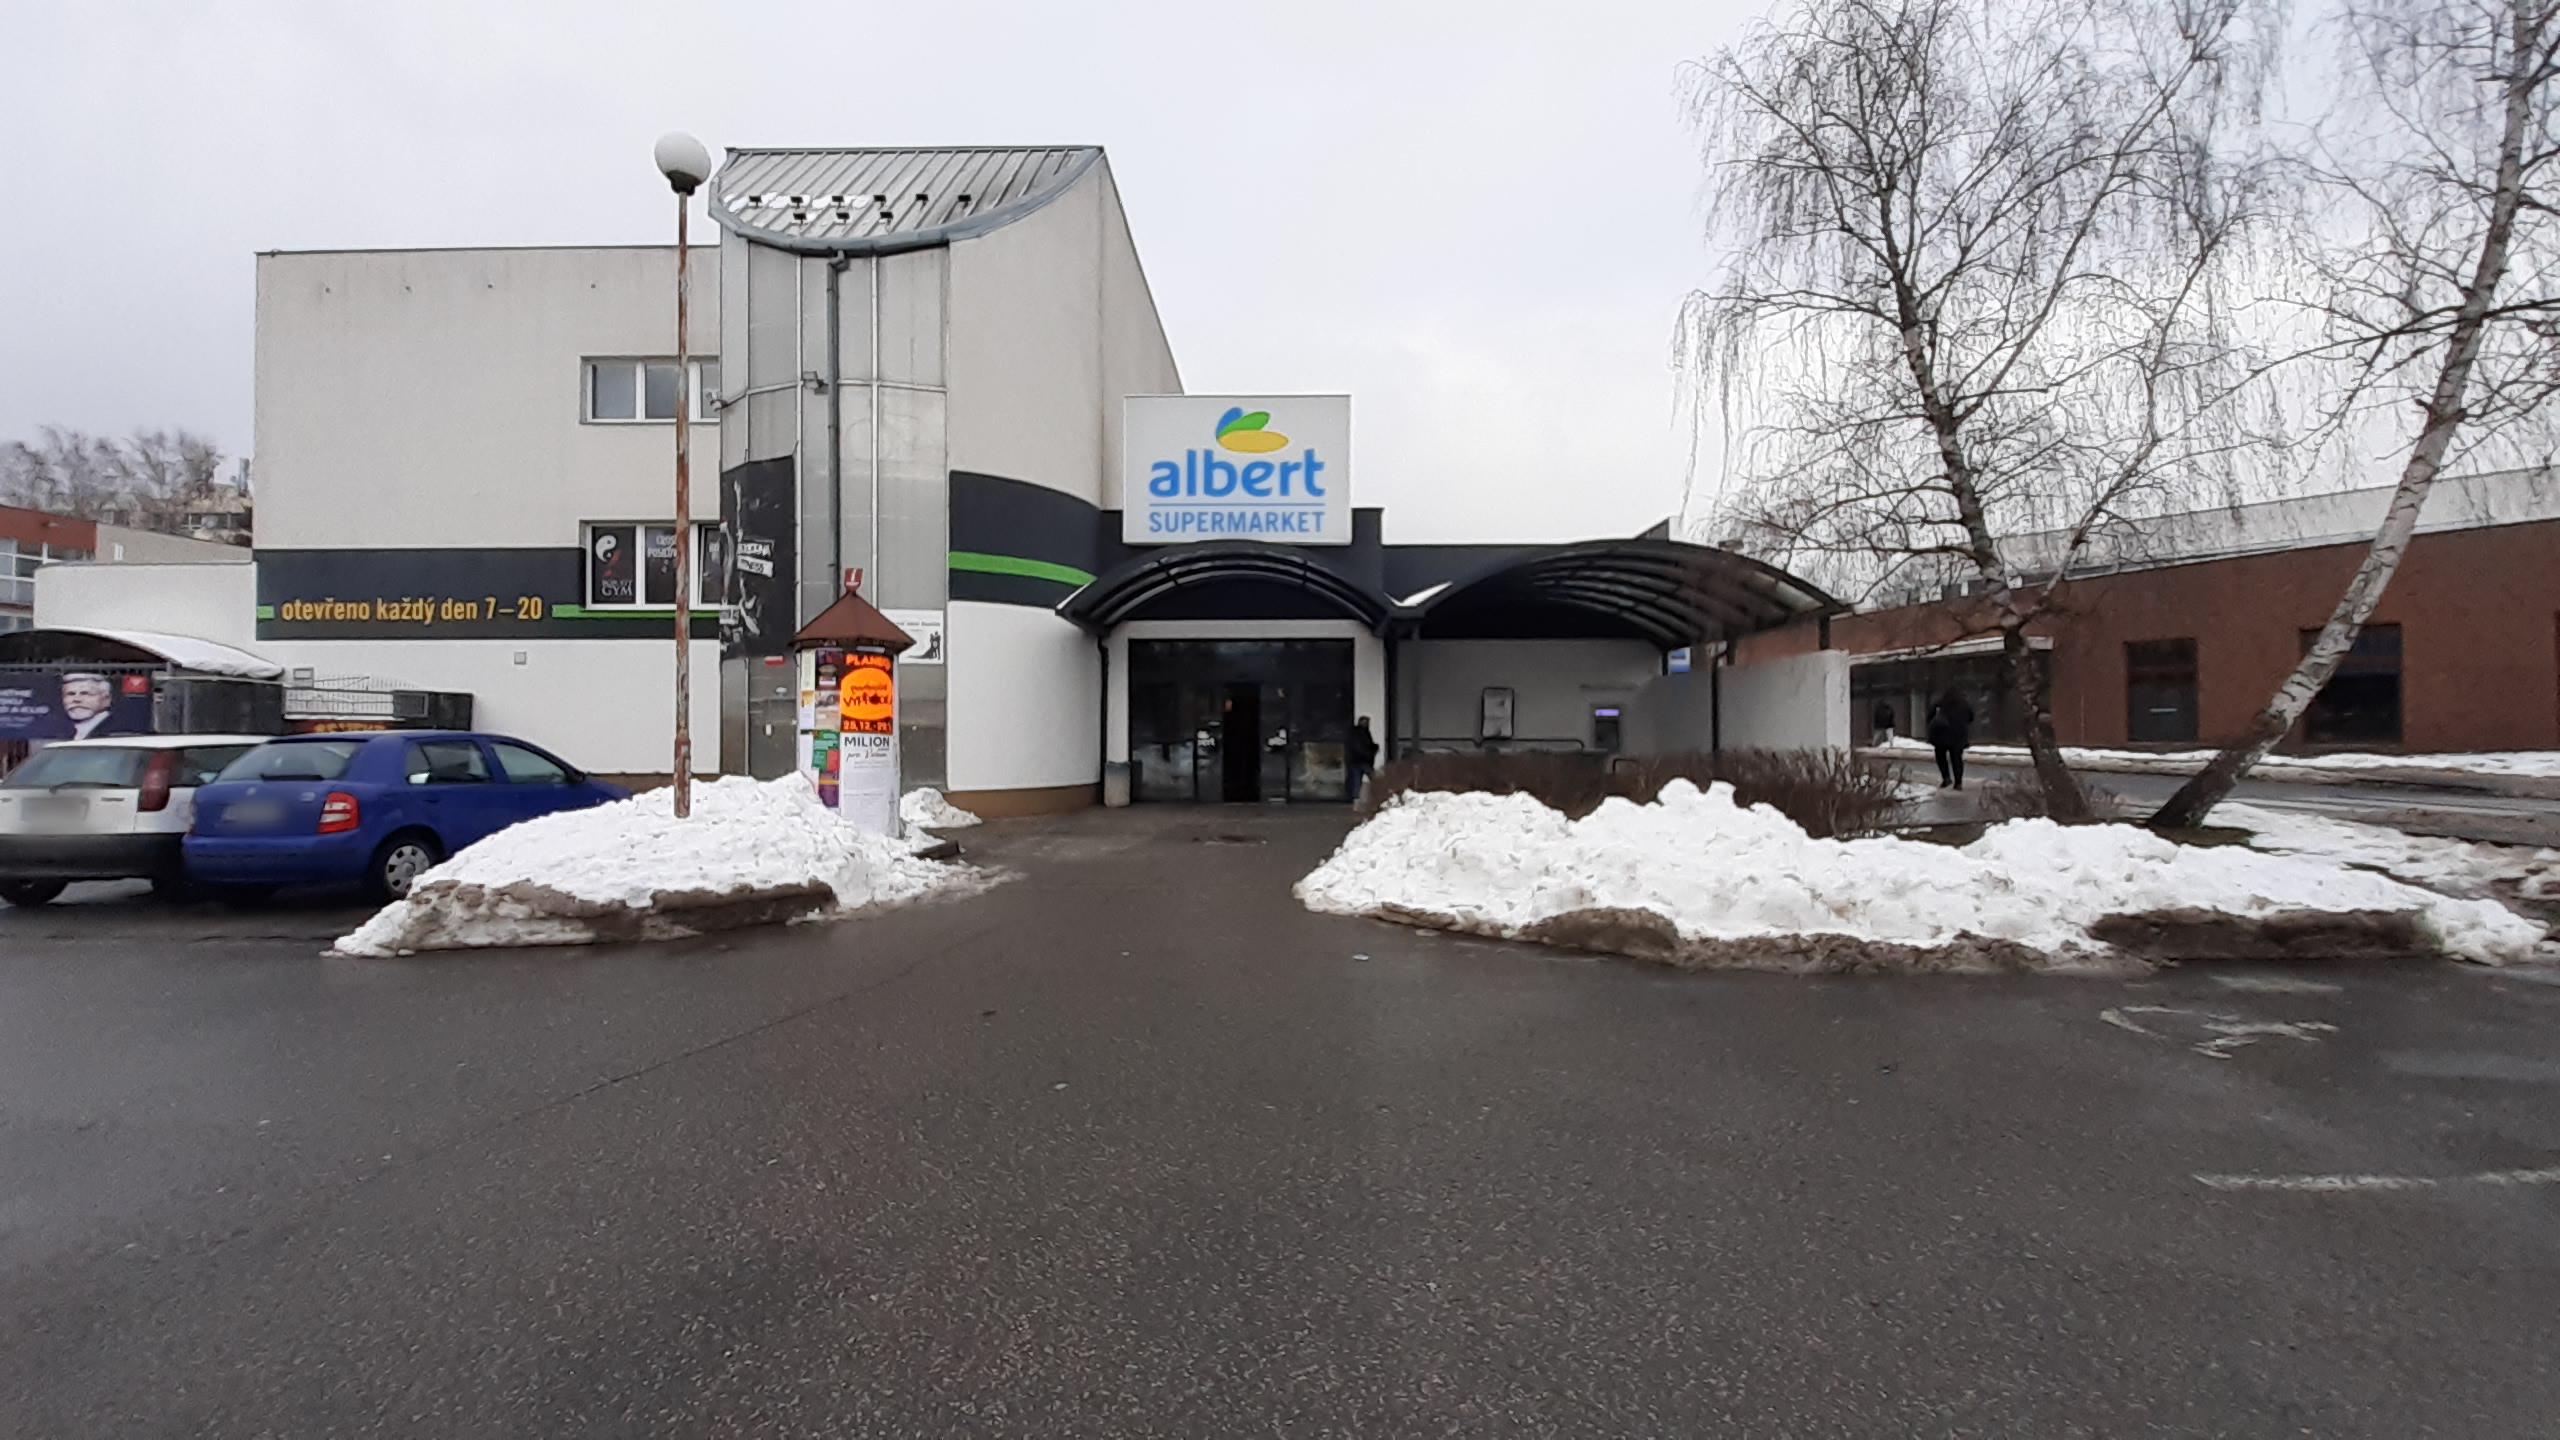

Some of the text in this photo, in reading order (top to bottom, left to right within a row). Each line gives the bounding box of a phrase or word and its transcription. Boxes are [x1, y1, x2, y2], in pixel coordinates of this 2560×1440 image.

[1148, 449, 1325, 498] albert
[1148, 511, 1326, 533] SUPERMARKET
[601, 584, 633, 597] GYM
[281, 597, 370, 620] otevřeno
[376, 597, 434, 625] každý
[441, 598, 477, 620] den
[844, 736, 890, 748] MILION
